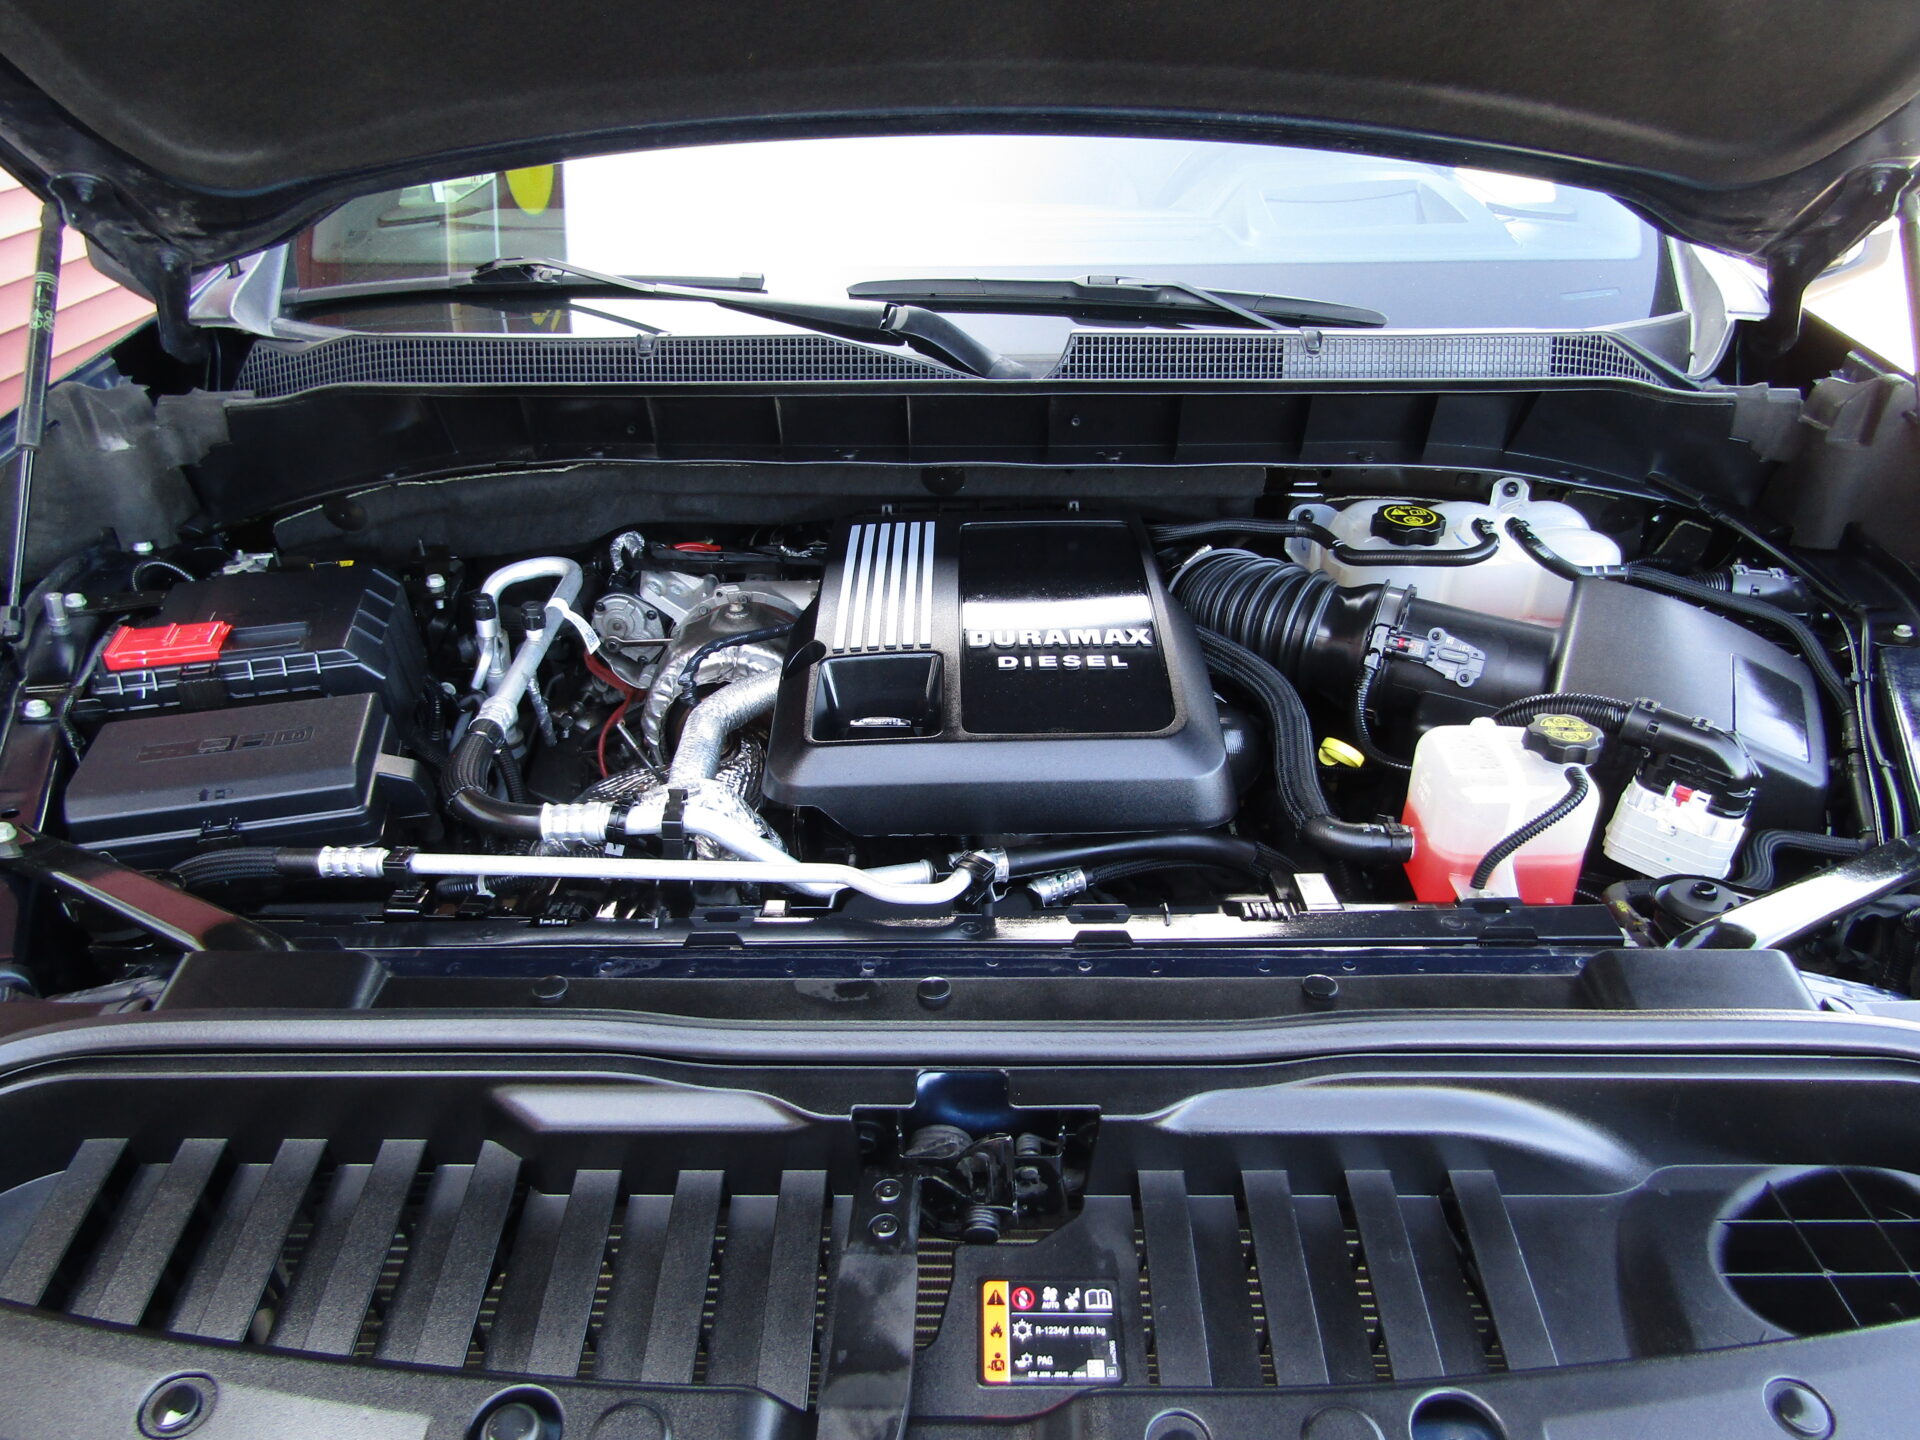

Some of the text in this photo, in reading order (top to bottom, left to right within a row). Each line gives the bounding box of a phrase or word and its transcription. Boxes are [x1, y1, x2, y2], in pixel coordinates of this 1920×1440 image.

[968, 628, 1153, 648] DURAMAX
[997, 655, 1129, 671] DIESEL
[1096, 1325, 1107, 1337] kg
[1037, 1355, 1054, 1366] PAG
